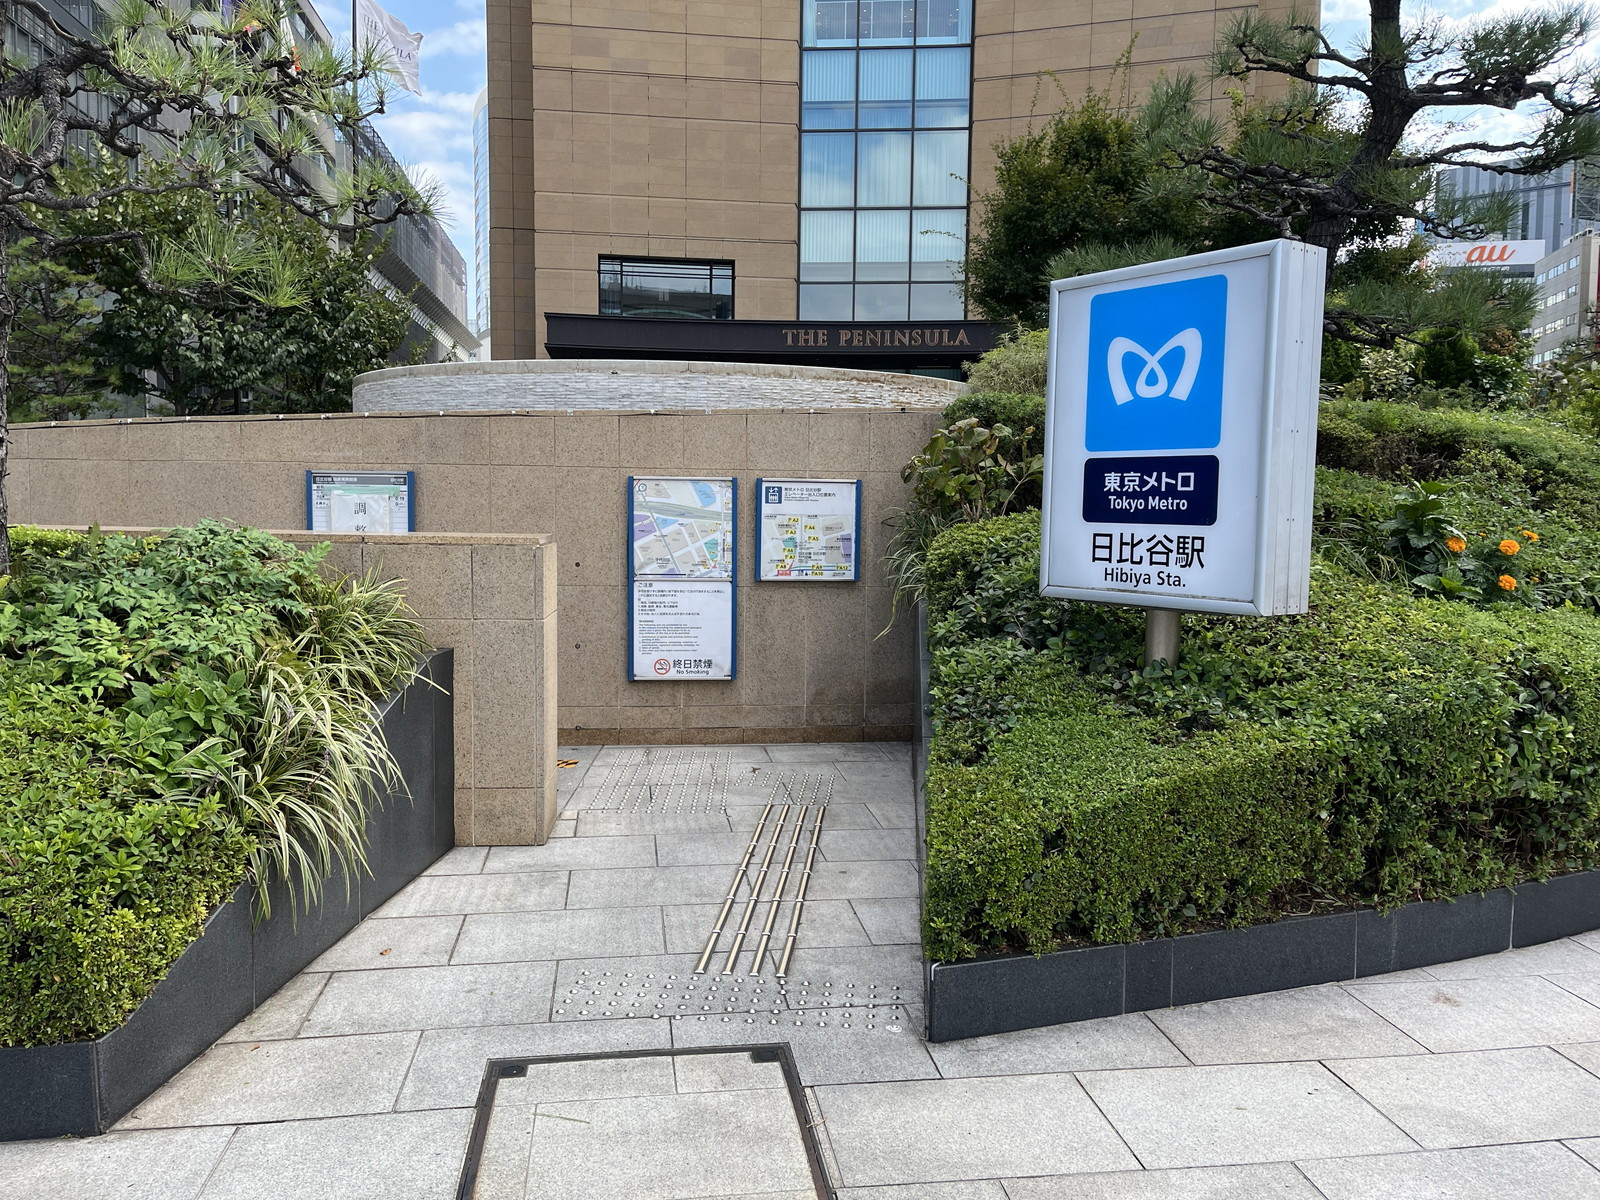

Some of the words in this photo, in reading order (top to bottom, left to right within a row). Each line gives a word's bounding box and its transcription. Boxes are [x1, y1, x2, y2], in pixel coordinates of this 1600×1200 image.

[1465, 244, 1516, 262] au
[782, 329, 828, 347] THE
[838, 328, 971, 348] PENINSULA
[1103, 471, 1195, 493] 東京メトロ
[1108, 495, 1145, 513] Tokyo
[1148, 497, 1188, 510] Metro
[1091, 532, 1205, 569] 日比谷駅
[1104, 567, 1151, 588] Hibiya
[1156, 571, 1187, 587] Sta.
[672, 660, 712, 668] 終日禁煙
